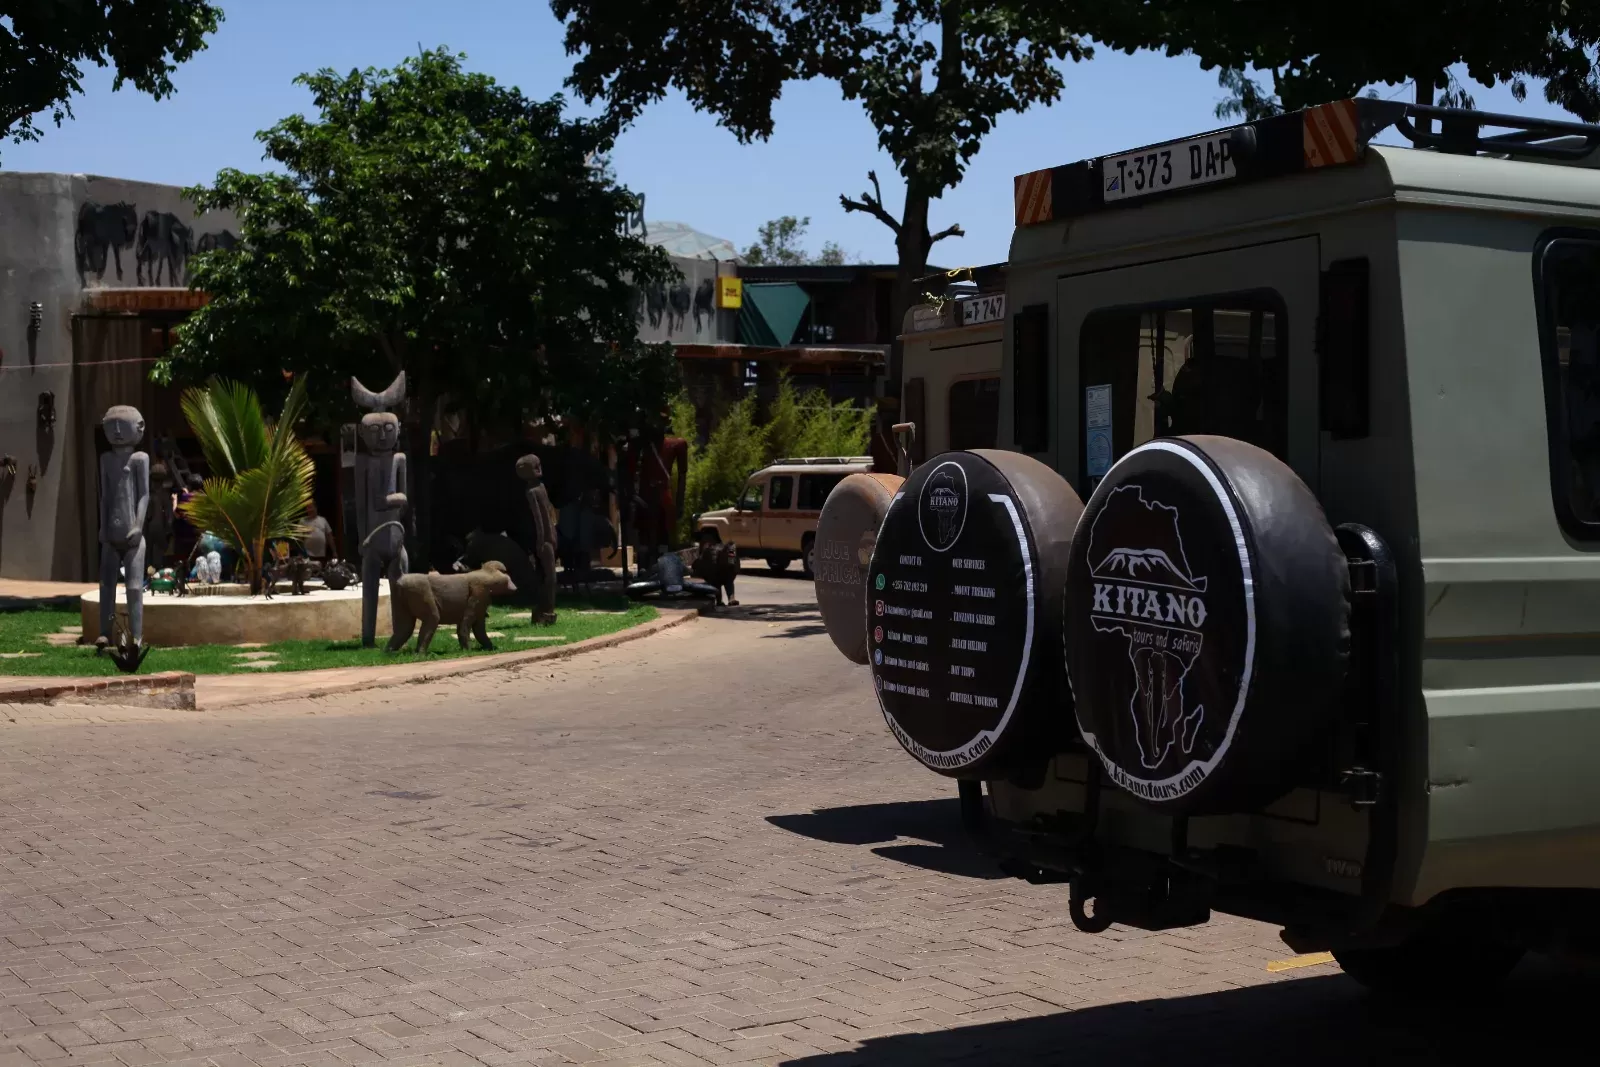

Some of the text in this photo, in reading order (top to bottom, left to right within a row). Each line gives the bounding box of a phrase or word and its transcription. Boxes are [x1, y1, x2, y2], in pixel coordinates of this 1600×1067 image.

[930, 496, 959, 506] KITANO
[952, 558, 986, 570] OUR SERVICES
[954, 585, 996, 598] MOUNT TREKKING
[1091, 583, 1208, 630] KITANO
[953, 611, 996, 626] TANZANIA SAFARIS
[951, 638, 967, 650] BEACH
[1133, 627, 1200, 655] tours and safaris
[907, 659, 915, 670] and
[950, 664, 975, 678] DAY TRIPS
[907, 685, 915, 696] and
[974, 695, 998, 708] TOURISM
[889, 717, 993, 768] www.kitanotours.com
